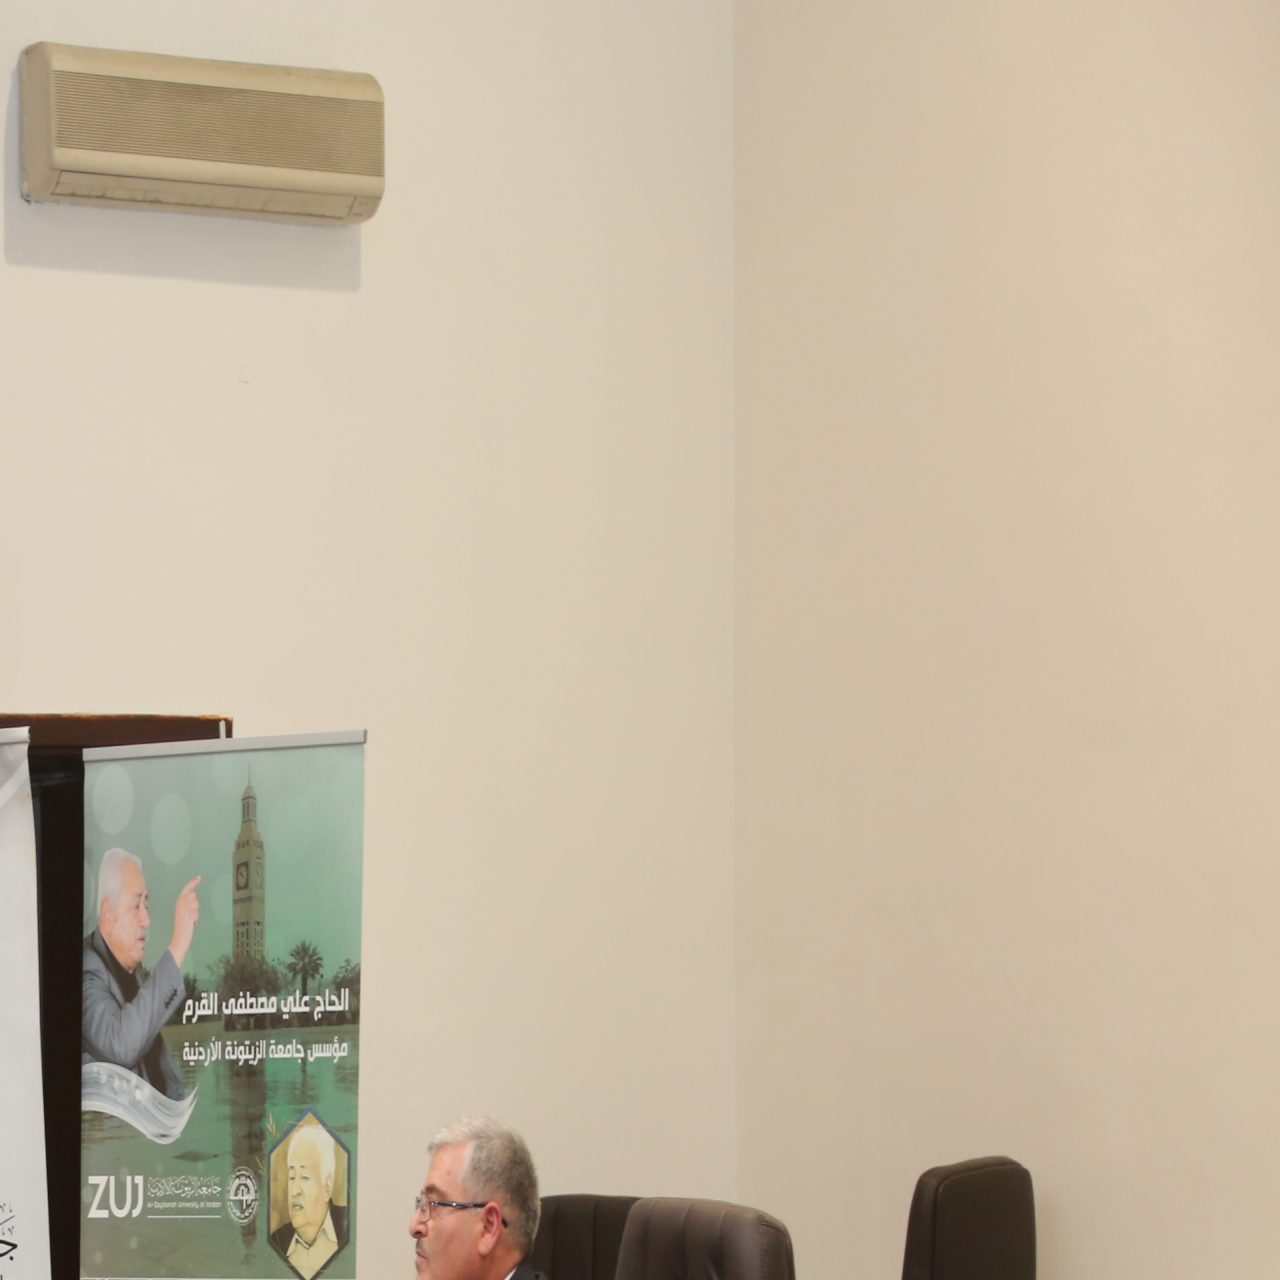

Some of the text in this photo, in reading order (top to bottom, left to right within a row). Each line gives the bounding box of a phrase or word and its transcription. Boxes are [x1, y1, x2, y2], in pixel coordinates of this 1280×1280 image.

[182, 987, 350, 1025] الحاج علي مصطفى القرم
[182, 1035, 348, 1067] مؤسس جامعة الزيتونة الأردنية
[87, 1175, 144, 1218] ZUJ
